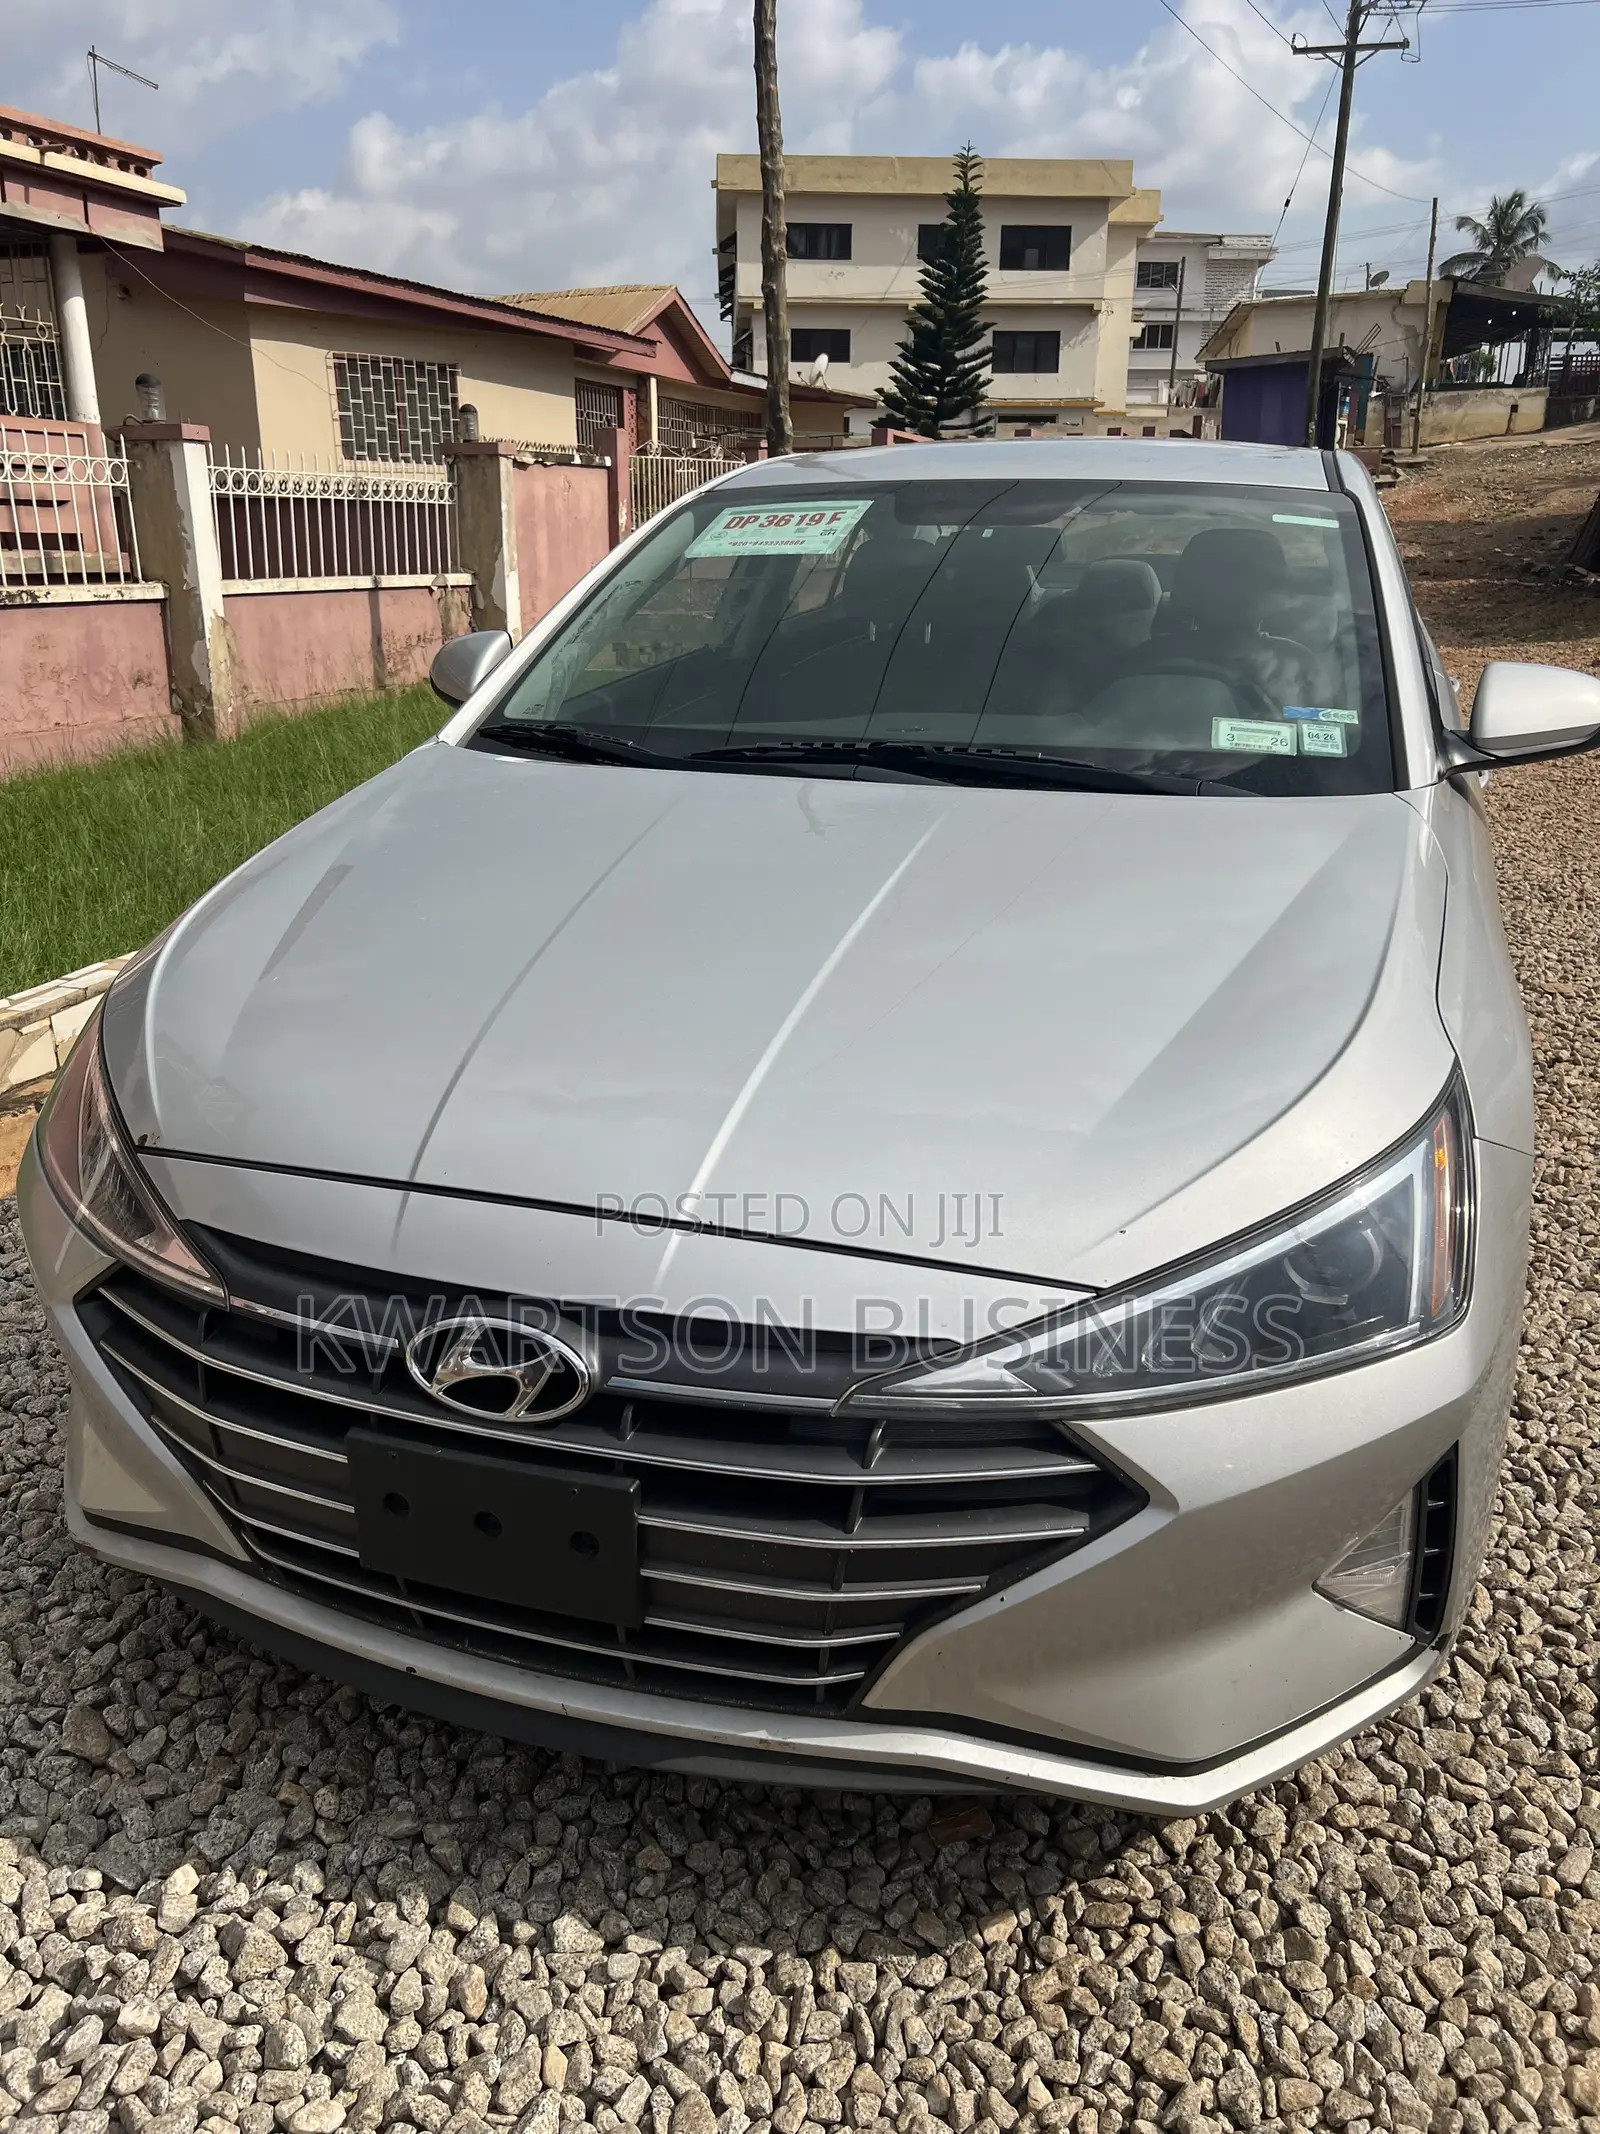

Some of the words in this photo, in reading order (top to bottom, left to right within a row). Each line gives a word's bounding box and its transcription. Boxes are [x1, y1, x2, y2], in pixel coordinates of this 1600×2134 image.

[723, 516, 760, 529] DP
[825, 511, 847, 526] F
[1226, 733, 1235, 742] 3
[1307, 731, 1320, 740] 04
[1323, 733, 1336, 741] 26
[1270, 737, 1289, 747] 26
